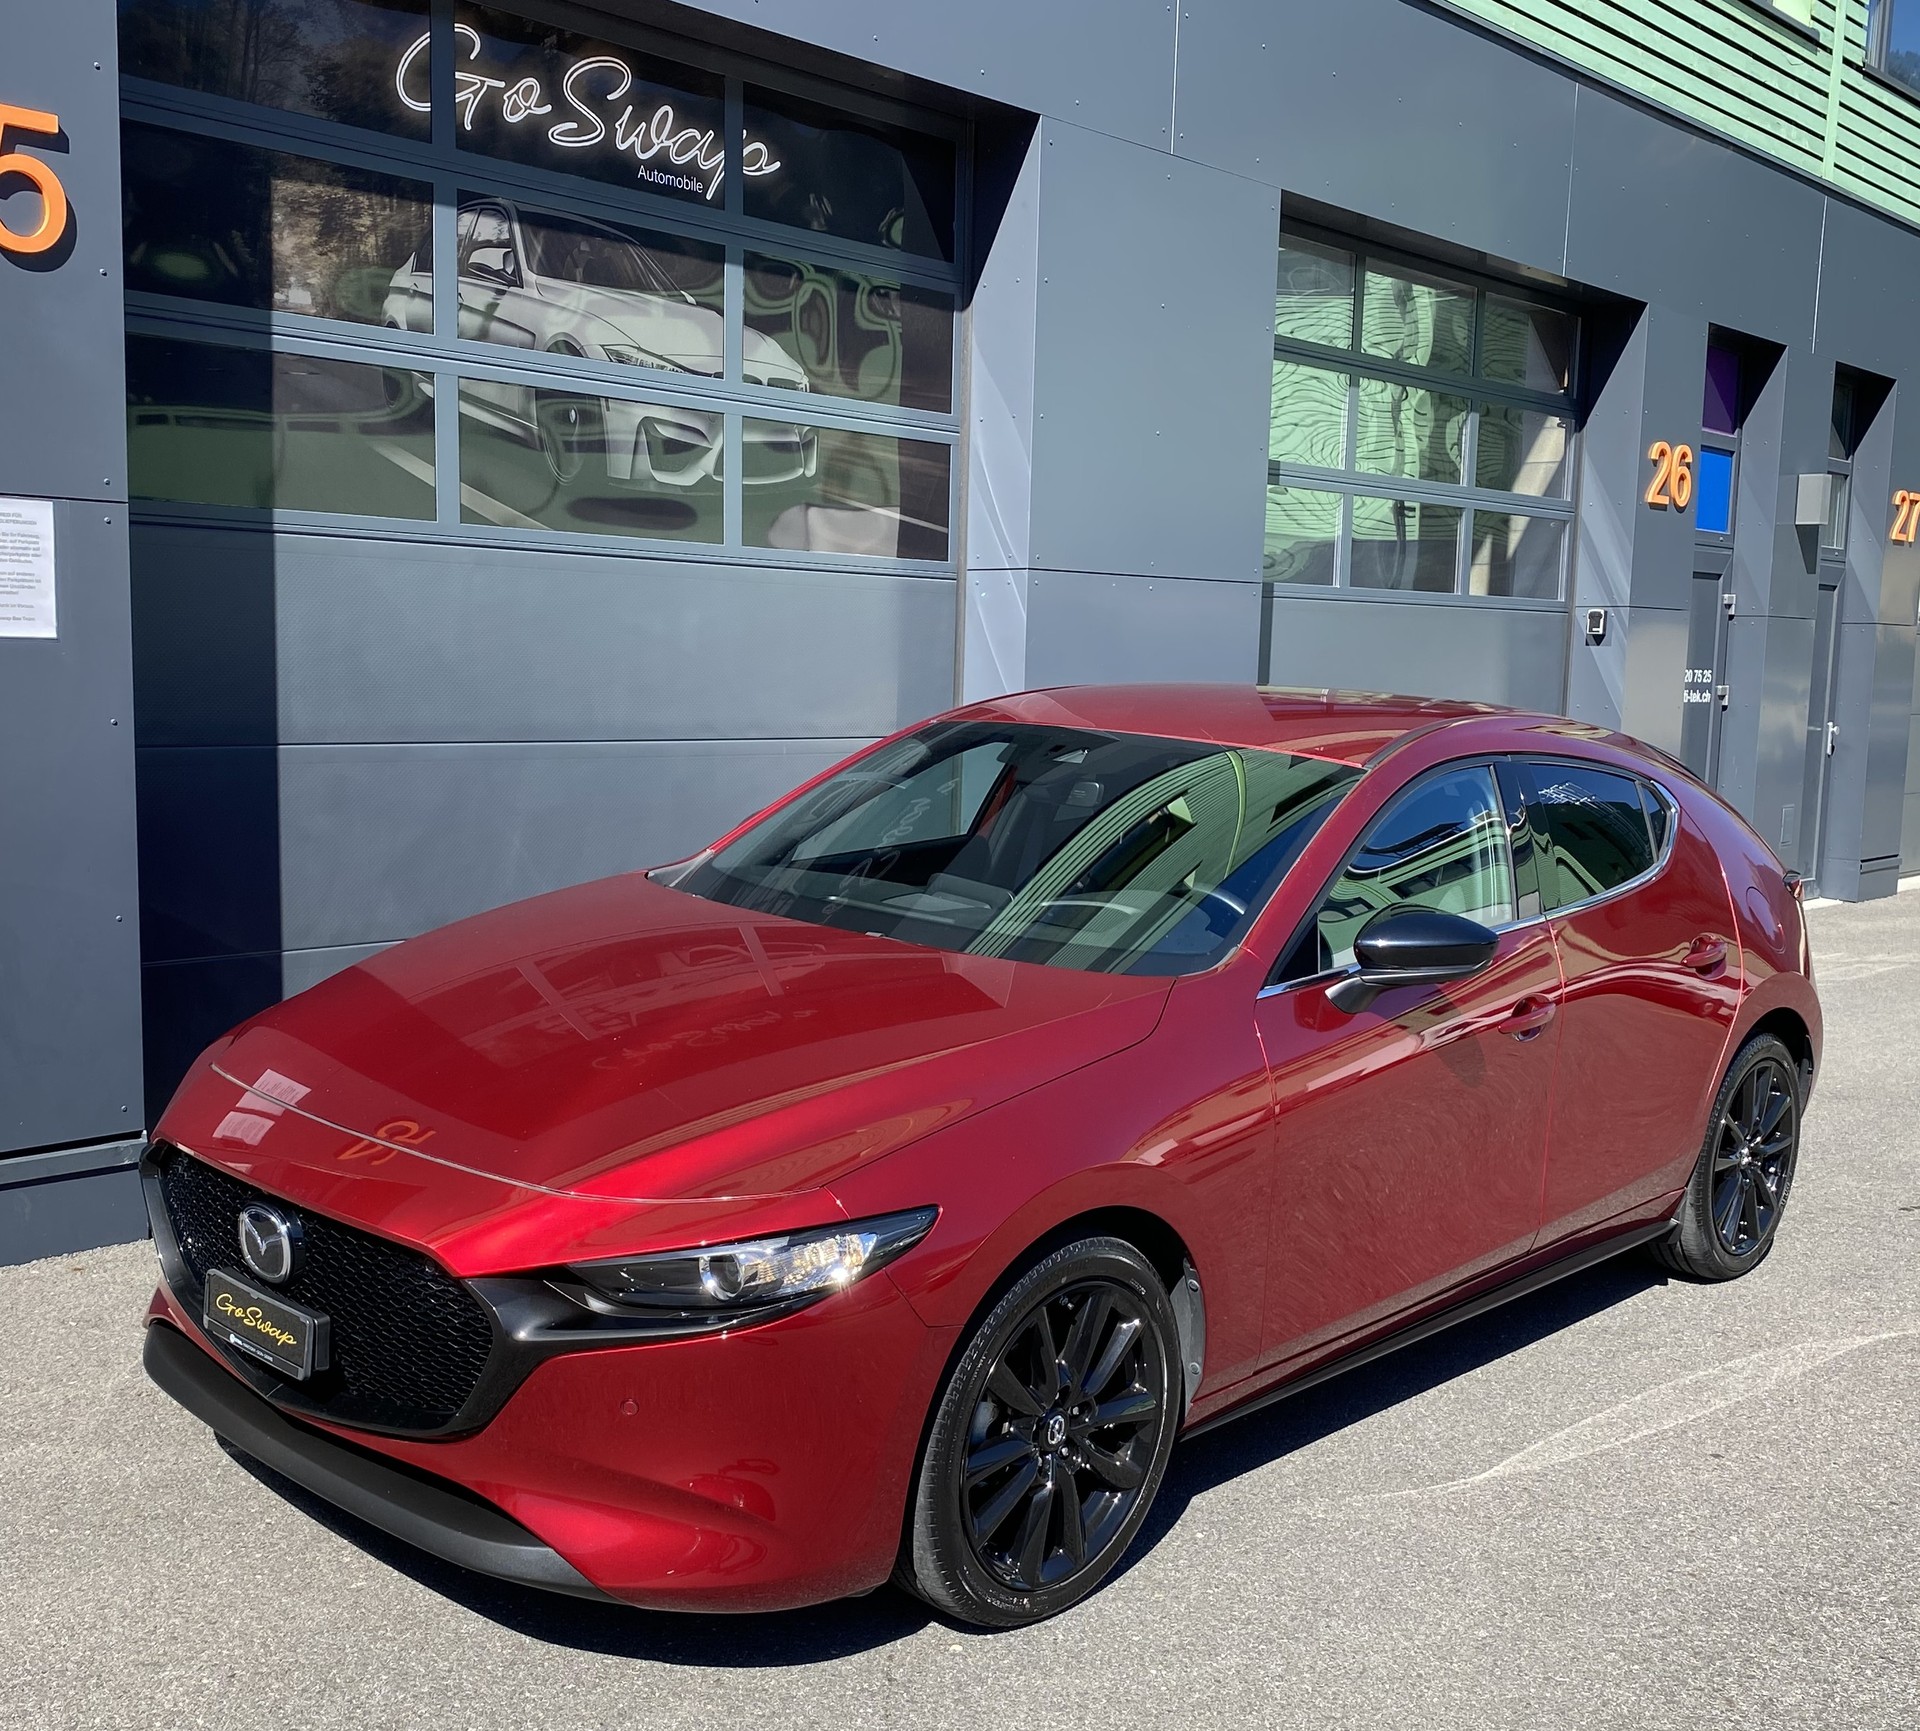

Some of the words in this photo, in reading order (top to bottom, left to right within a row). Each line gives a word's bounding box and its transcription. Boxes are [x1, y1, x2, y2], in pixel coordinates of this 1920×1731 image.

[637, 165, 703, 194] Automobile
[1645, 441, 1693, 507] 26
[1889, 490, 1920, 542] 27
[1684, 669, 1693, 683] 20
[1693, 669, 1703, 683] 75
[1702, 669, 1712, 683] 25
